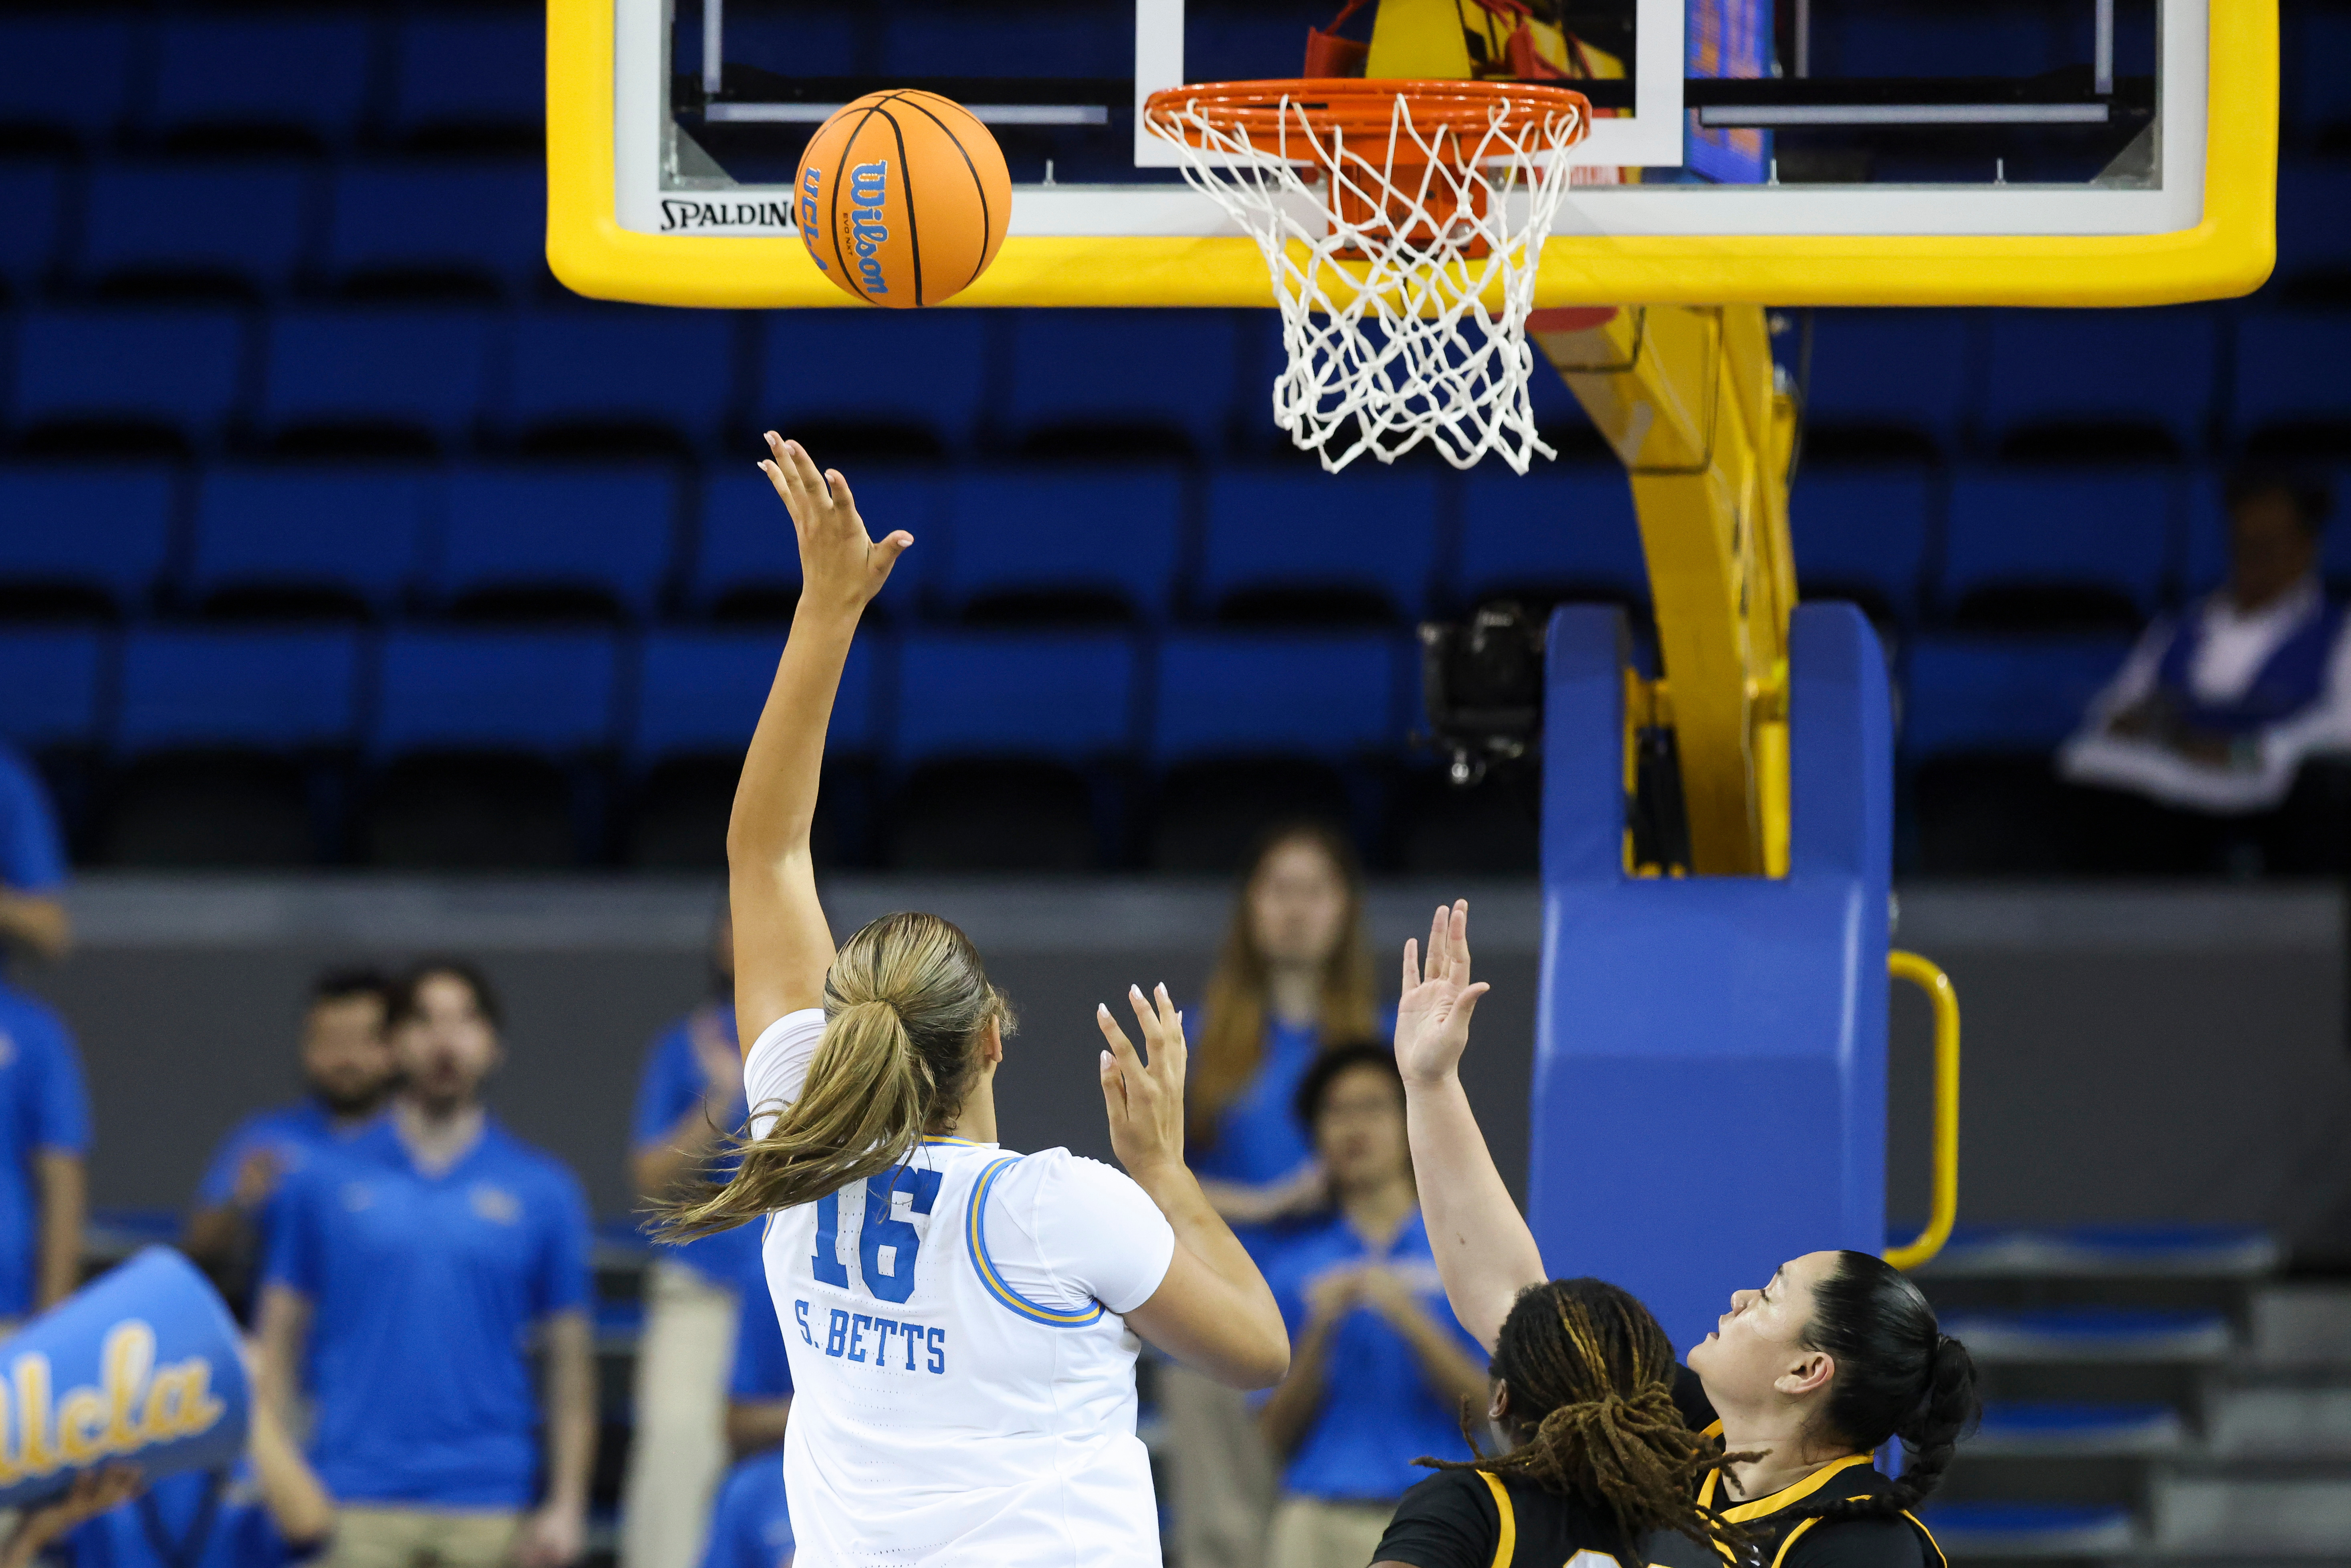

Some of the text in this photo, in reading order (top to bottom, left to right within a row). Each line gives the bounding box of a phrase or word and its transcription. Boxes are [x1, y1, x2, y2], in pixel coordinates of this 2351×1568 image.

[661, 200, 797, 231] SPALDIN
[850, 159, 889, 294] Wilson
[811, 1164, 943, 1304] 16
[826, 1308, 945, 1374] BETTS
